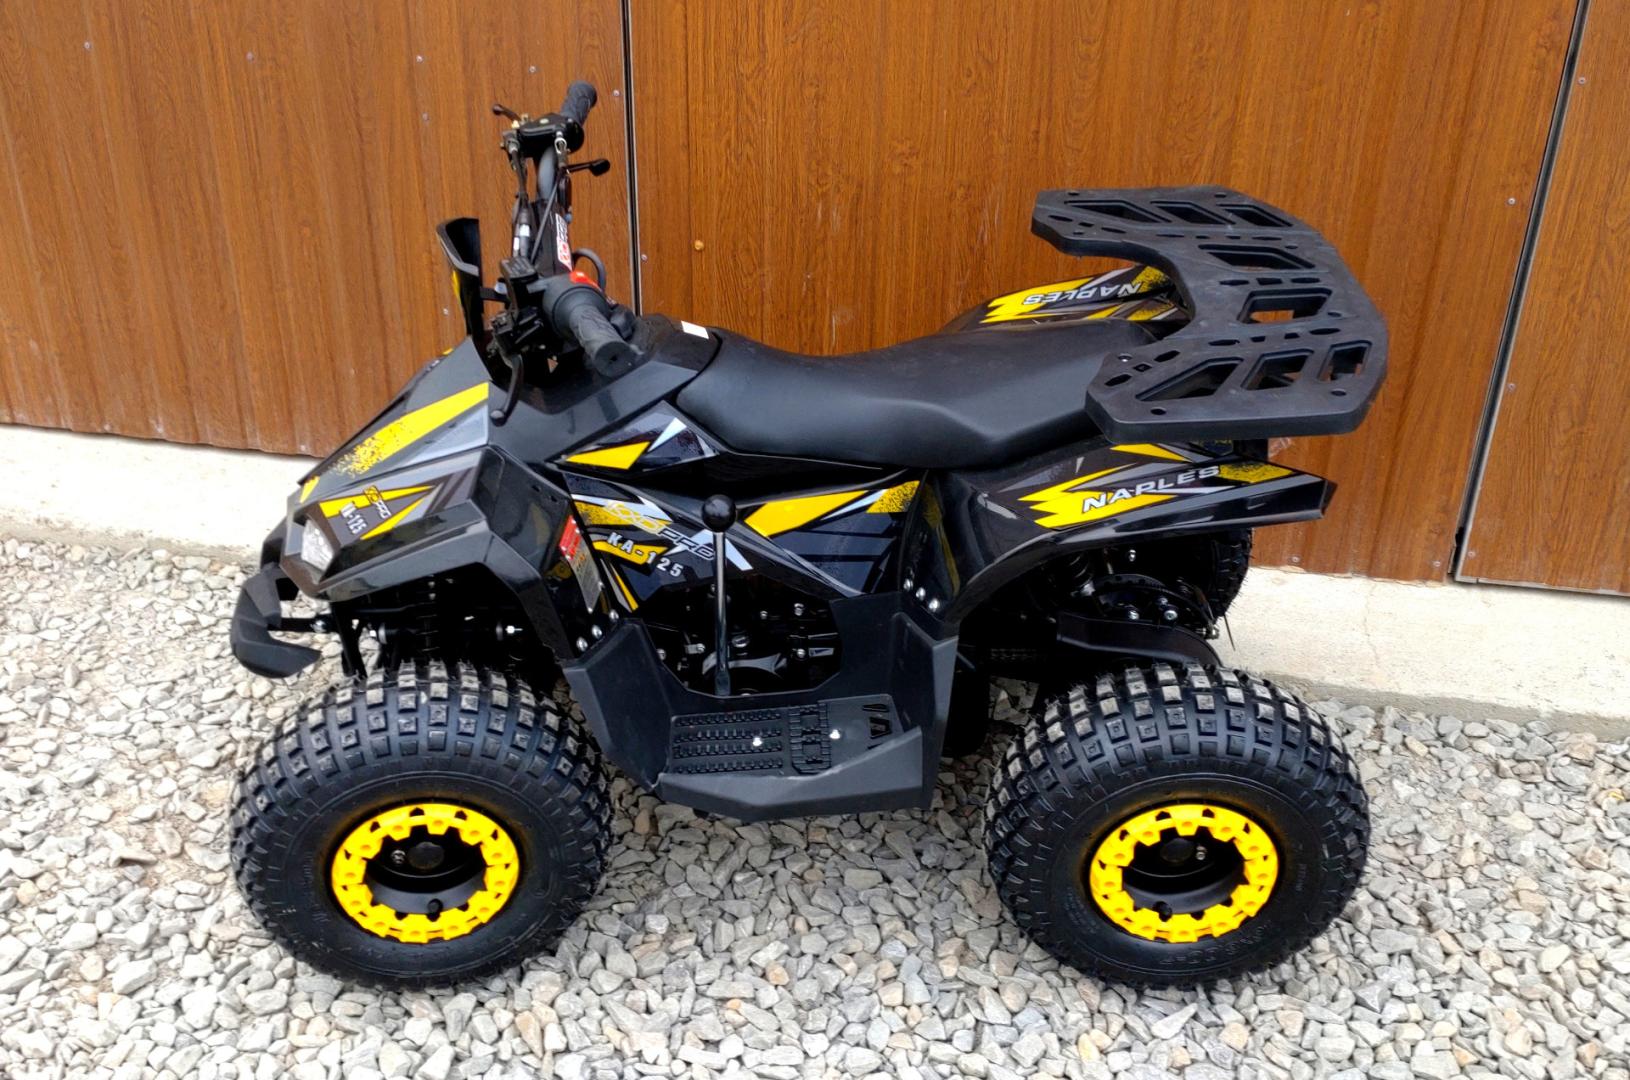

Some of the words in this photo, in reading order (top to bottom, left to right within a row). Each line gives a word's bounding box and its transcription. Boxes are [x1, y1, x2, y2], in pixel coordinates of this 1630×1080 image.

[1023, 282, 1142, 305] NAPLES
[1082, 465, 1220, 513] NAPLES
[608, 532, 684, 578] KA-125
